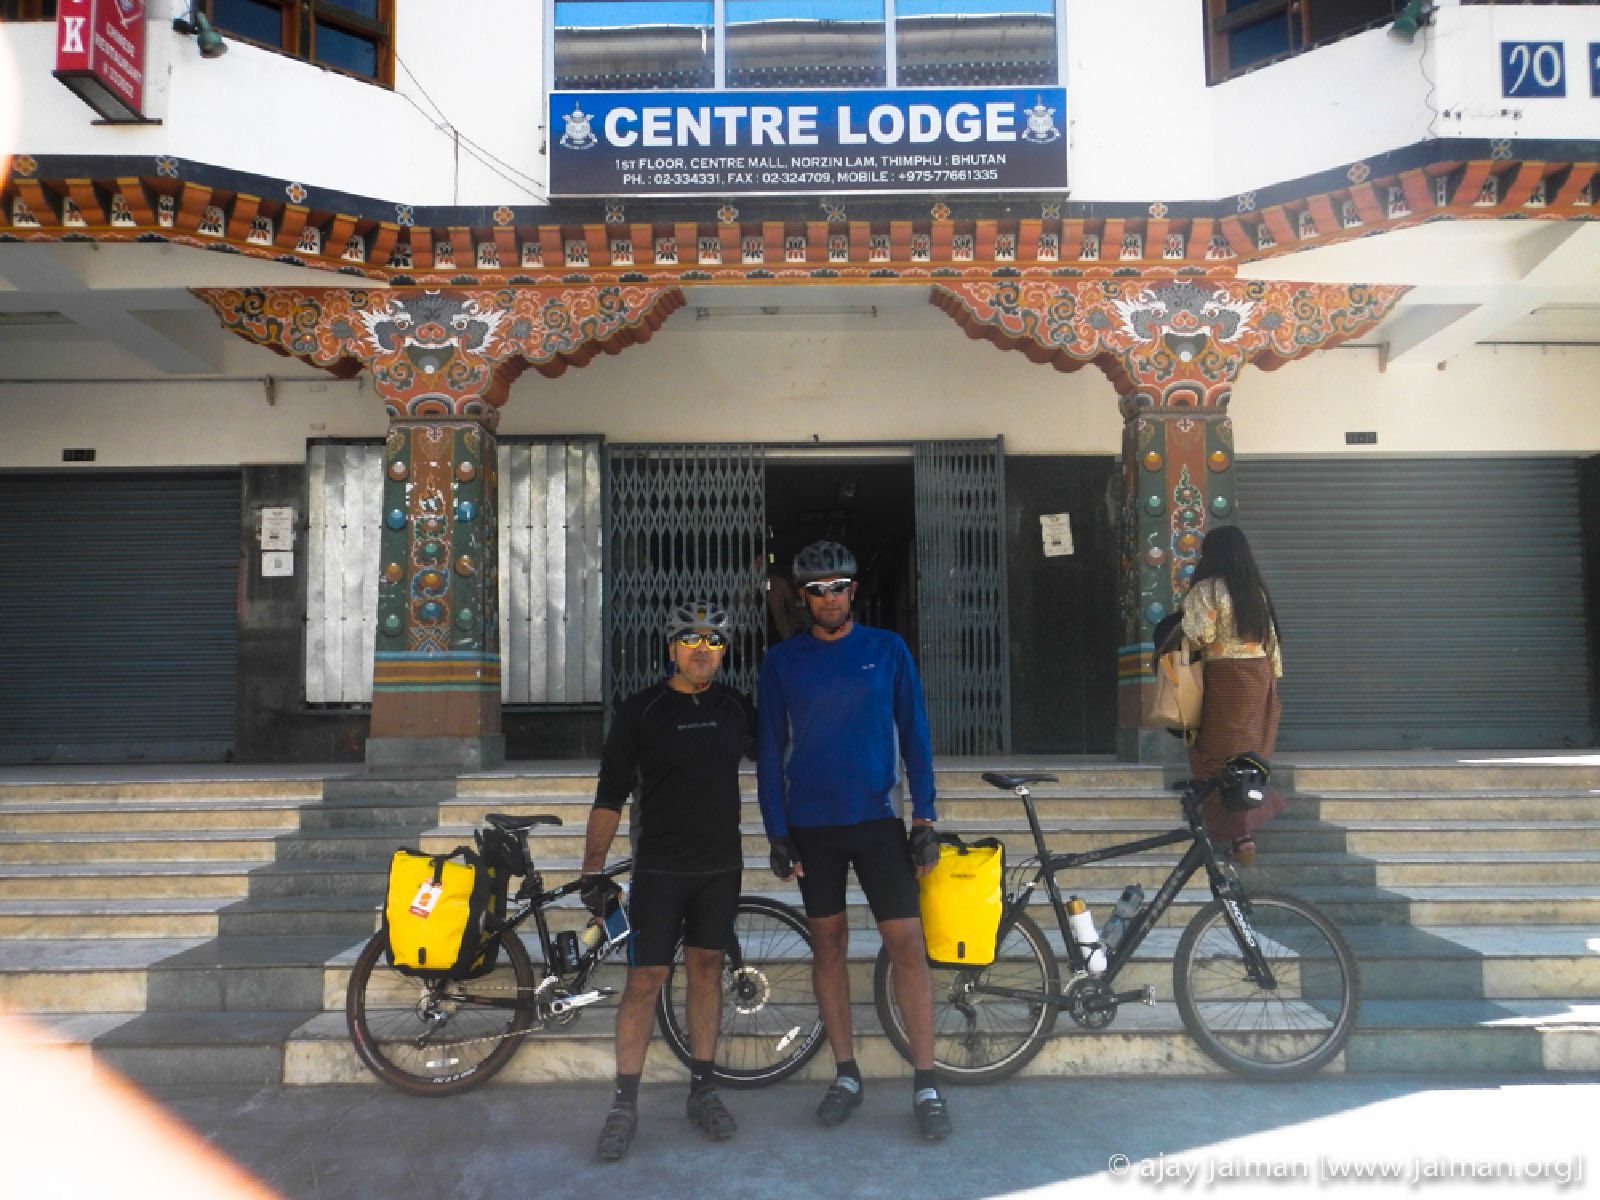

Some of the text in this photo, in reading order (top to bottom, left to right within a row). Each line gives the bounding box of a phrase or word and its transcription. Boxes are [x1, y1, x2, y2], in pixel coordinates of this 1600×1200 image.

[62, 0, 85, 53] K
[603, 102, 1017, 147] CENTRE LODGE
[639, 158, 687, 170] FLOOR,
[690, 157, 745, 169] CENTRE
[748, 157, 788, 169] MALL,
[791, 156, 843, 167] NORZIN
[845, 156, 878, 168] LAM,
[881, 155, 942, 167] THIMPHU
[951, 154, 1007, 166] BHUTAN
[727, 172, 753, 183] FAX
[762, 171, 835, 184] 02-324709,
[837, 171, 888, 183] MOBILE
[898, 169, 998, 182] +975-77661335
